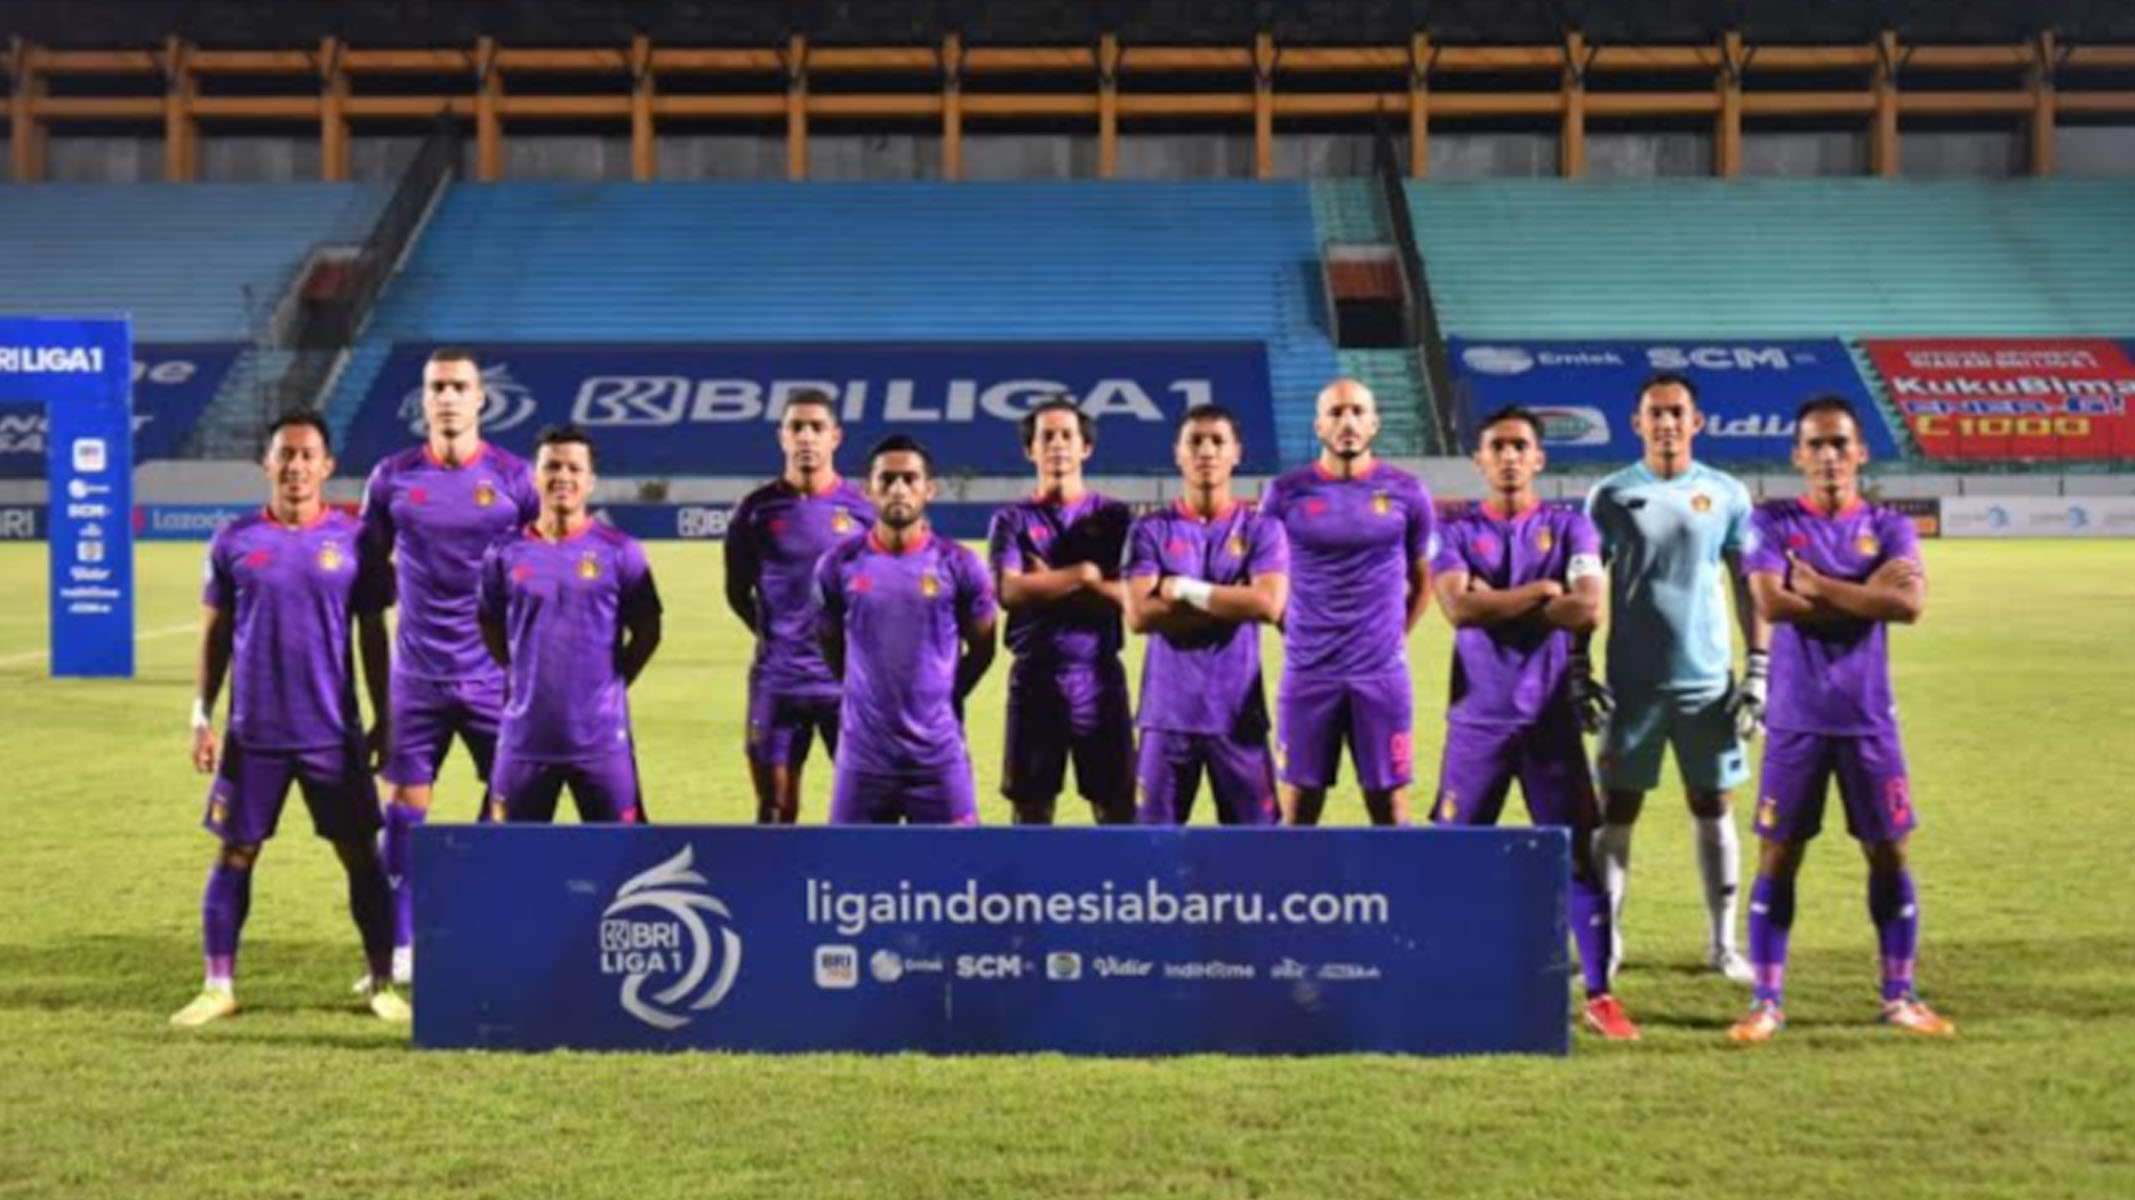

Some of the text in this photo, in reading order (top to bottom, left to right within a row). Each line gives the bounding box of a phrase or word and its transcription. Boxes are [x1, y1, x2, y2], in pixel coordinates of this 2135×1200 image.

[1647, 346, 1789, 370] SCM
[806, 878, 1389, 935] ligaindonesiabaru.com
[632, 922, 680, 948] BRI
[956, 955, 1021, 977] SCM
